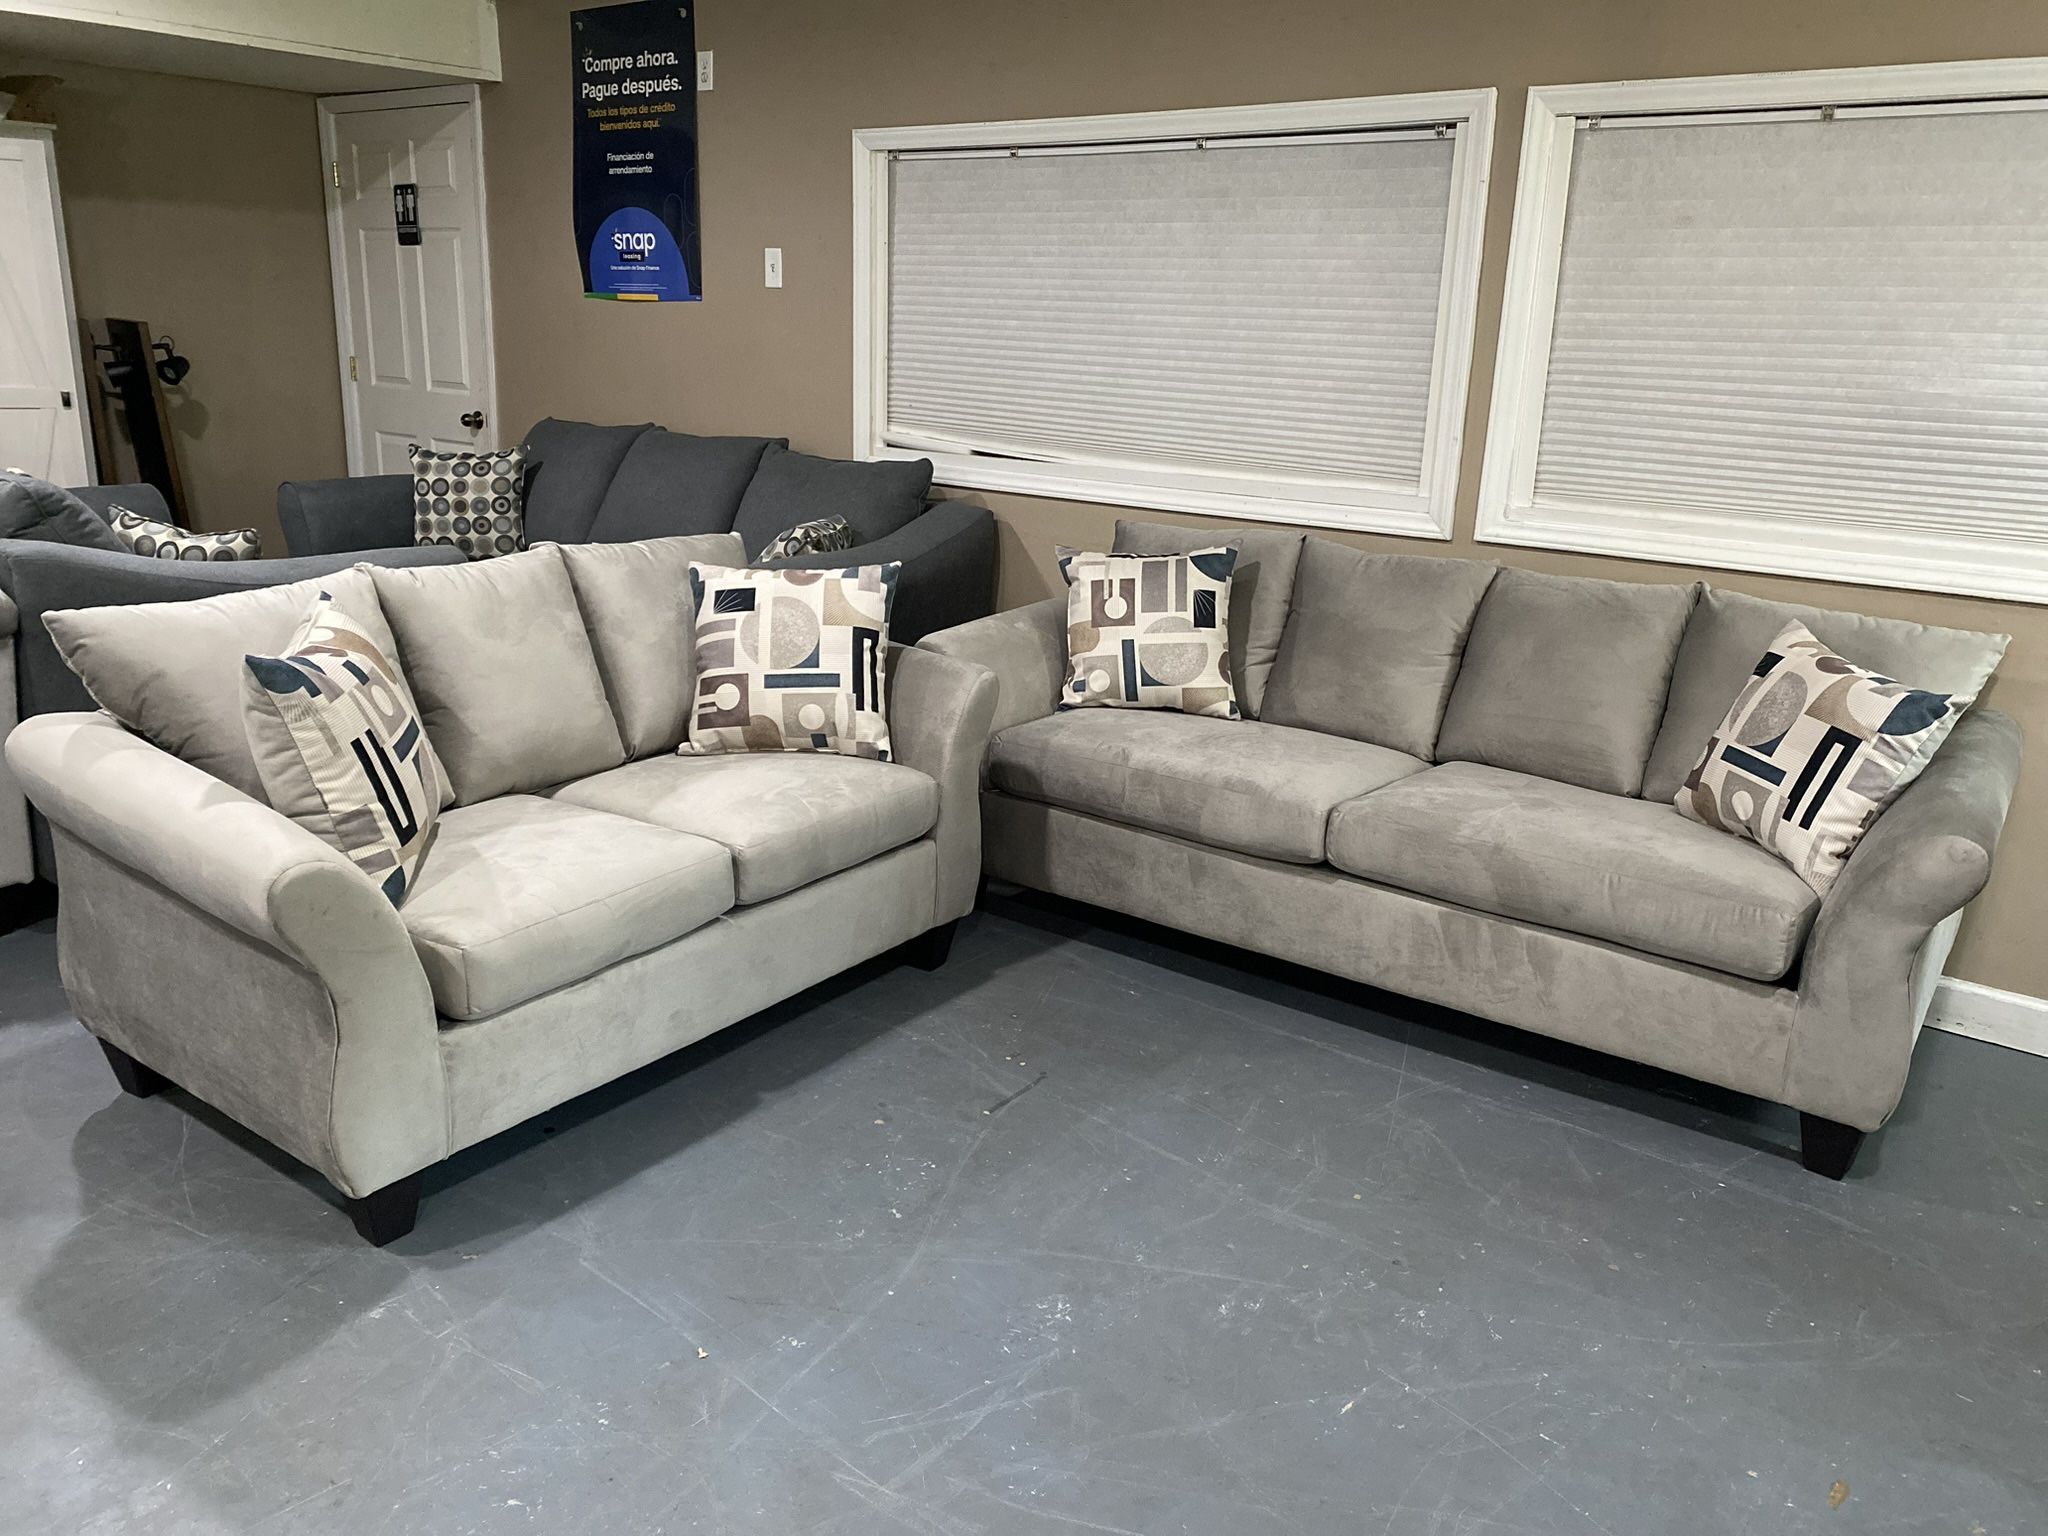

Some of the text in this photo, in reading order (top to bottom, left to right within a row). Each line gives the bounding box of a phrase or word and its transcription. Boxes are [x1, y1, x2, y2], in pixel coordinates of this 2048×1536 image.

[585, 51, 678, 74] Compre ahora.
[582, 75, 682, 101] Pague después.
[587, 102, 675, 118] Todos los tipos de crédito
[600, 120, 641, 131] bienvenidos
[607, 151, 654, 161] Financiación de
[609, 165, 652, 174] arrendamiento
[614, 232, 656, 257] snap
